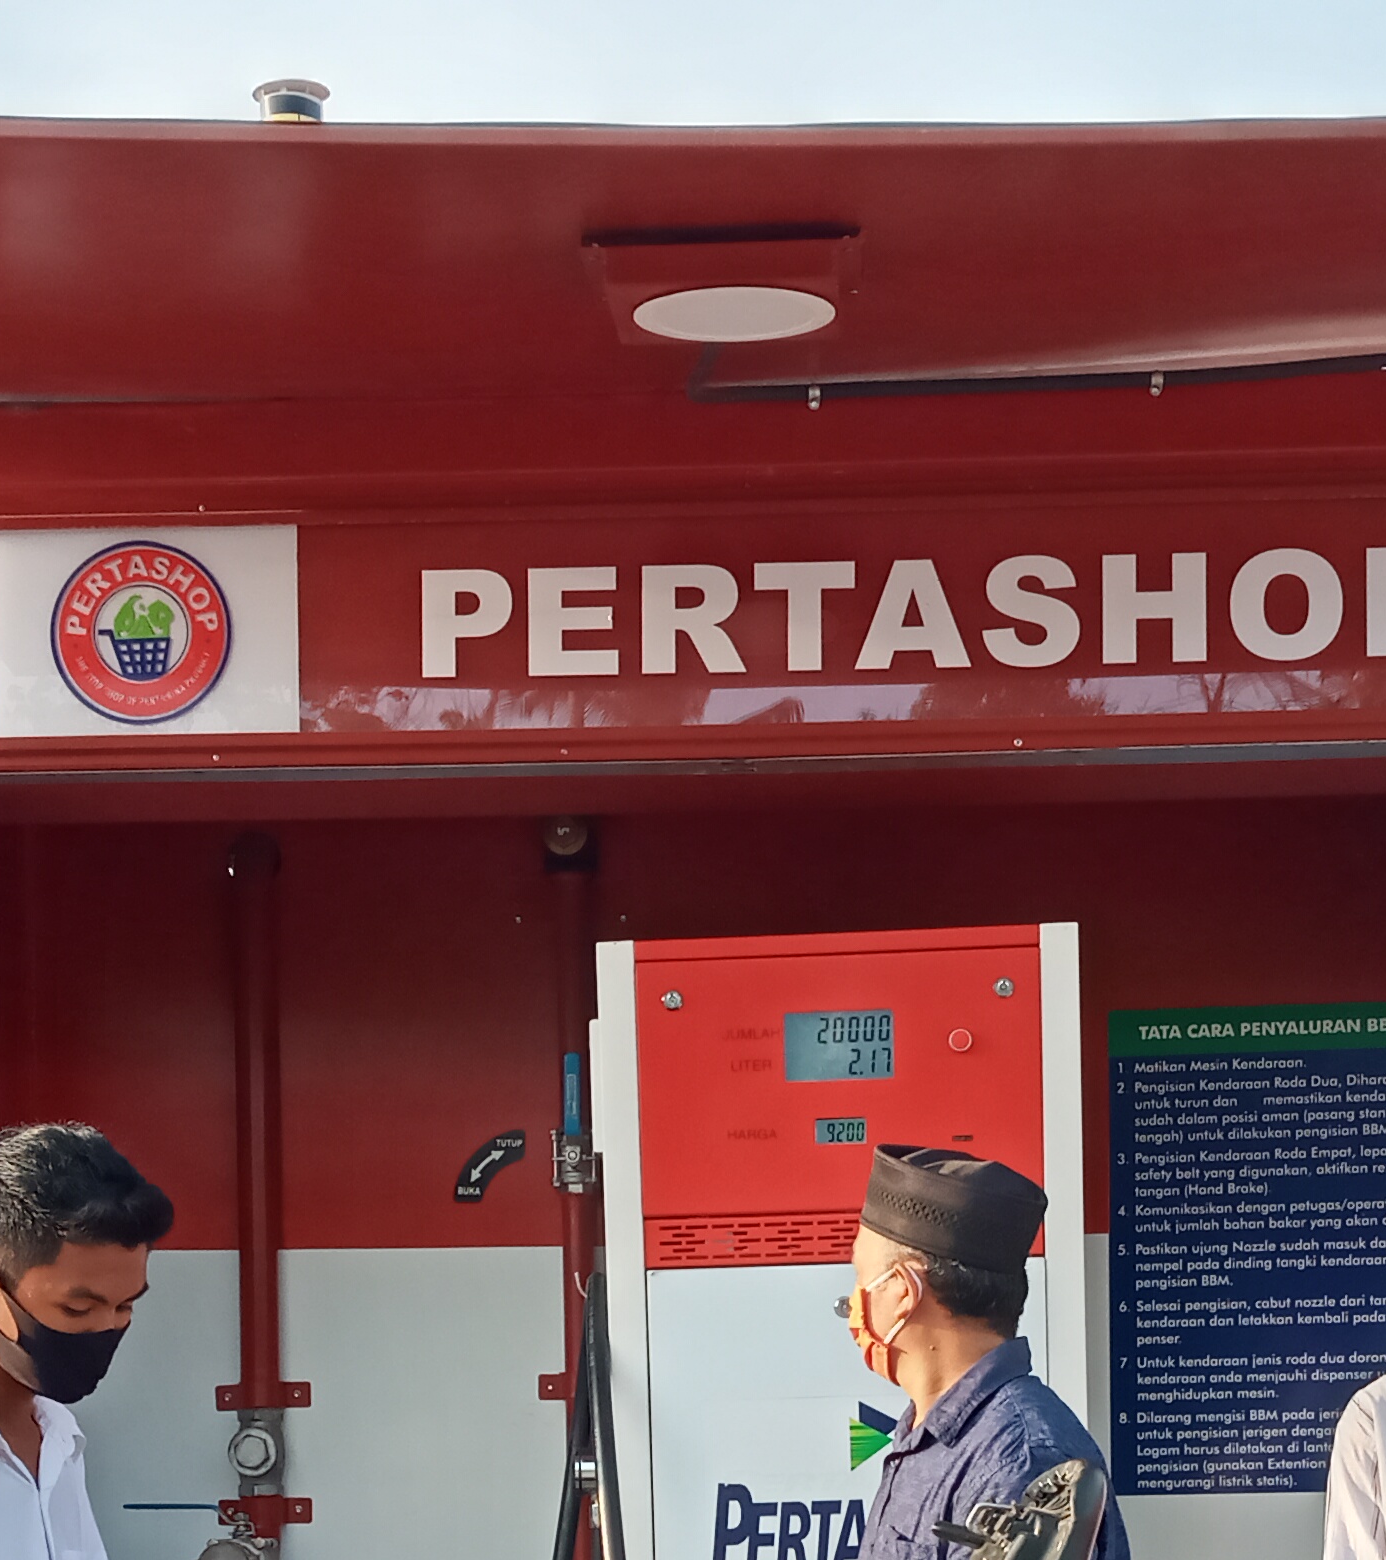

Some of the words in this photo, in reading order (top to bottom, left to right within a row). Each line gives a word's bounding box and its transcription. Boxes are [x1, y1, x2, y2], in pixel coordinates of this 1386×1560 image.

[65, 554, 219, 636] PERTASHOP
[722, 1028, 781, 1041] JUMLAH
[817, 1014, 891, 1045] 20000
[1139, 1025, 1181, 1040] TATA
[1187, 1023, 1234, 1038] CARA
[1240, 1018, 1360, 1036] PENYALURAN
[730, 1059, 773, 1073] LITER
[848, 1046, 892, 1076] 2.17
[1134, 1059, 1185, 1073] Matikan
[1190, 1059, 1228, 1071] Mesin
[1232, 1057, 1306, 1069] Kendaraan.
[1135, 1081, 1195, 1095] Pengisian
[1199, 1078, 1269, 1091] Kendaraan
[1275, 1077, 1306, 1088] Roda
[1311, 1075, 1342, 1088] Dua,
[1135, 1096, 1171, 1109] untuk
[1175, 1096, 1209, 1107] turun
[1213, 1095, 1237, 1107] dan
[1263, 1091, 1342, 1105] memastikan
[1135, 1113, 1173, 1126] sudah
[1177, 1112, 1217, 1125] dalam
[1222, 1111, 1258, 1126] posisi
[1262, 1112, 1299, 1122] aman
[1303, 1109, 1355, 1124] (pasang
[726, 1128, 778, 1141] HARGA
[826, 1121, 866, 1143] 9200
[1135, 1129, 1183, 1145] tengah)
[1188, 1128, 1224, 1140] untuk
[1228, 1125, 1291, 1140] dilakukan
[1295, 1126, 1357, 1139] pengisian
[495, 1138, 524, 1149] TUTUP
[1117, 1153, 1128, 1164] 3.
[1135, 1151, 1195, 1166] Pengisian
[1199, 1149, 1270, 1162] Kendaraan
[1275, 1148, 1306, 1159] Roda
[1311, 1147, 1356, 1160] Empat,
[1135, 1167, 1172, 1182] safety
[1176, 1167, 1200, 1179] belt
[1203, 1168, 1235, 1180] yang
[1239, 1164, 1311, 1179] digunakan,
[1316, 1163, 1368, 1174] aktifkan
[457, 1186, 482, 1196] BUKA
[1135, 1185, 1180, 1200] tangan
[1184, 1183, 1224, 1198] (Hand
[1135, 1202, 1232, 1216] Komunikasikan
[1237, 1201, 1285, 1215] dengan
[1135, 1220, 1171, 1233] untuk
[1175, 1219, 1219, 1233] jumlah
[1224, 1217, 1265, 1230] bahan
[1269, 1216, 1306, 1229] bakar
[1310, 1218, 1341, 1231] yang
[1345, 1216, 1378, 1227] akan
[1118, 1244, 1129, 1255] 5.
[1135, 1243, 1187, 1255] Pastikan
[1192, 1242, 1228, 1257] ujung
[1233, 1241, 1276, 1252] Nozzle
[1280, 1239, 1319, 1252] sudah
[1323, 1238, 1366, 1250] masuk
[1135, 1258, 1183, 1274] nempel
[1187, 1258, 1219, 1272] pada
[1224, 1256, 1272, 1271] dinding
[1276, 1254, 1317, 1268] tangki
[1135, 1276, 1196, 1291] pengisian
[1201, 1275, 1233, 1287] BBM.
[1119, 1301, 1130, 1312] 6.
[1136, 1299, 1181, 1312] Selesai
[1185, 1299, 1251, 1312] pengisian,
[1255, 1297, 1290, 1309] cabut
[1295, 1296, 1335, 1307] nozzle
[1340, 1294, 1365, 1306] dari
[1136, 1316, 1205, 1328] kendaraan
[1209, 1314, 1234, 1327] dan
[1238, 1313, 1292, 1325] letakkan
[1297, 1311, 1349, 1324] kembali
[1353, 1311, 1386, 1325] pada
[1137, 1356, 1175, 1369] Untuk
[1179, 1354, 1248, 1367] kendaraan
[1252, 1353, 1282, 1368] jenis
[1286, 1353, 1315, 1365] roda
[1320, 1352, 1344, 1364] dua
[1137, 1371, 1205, 1385] kendaraan
[1209, 1370, 1242, 1383] anda
[1247, 1367, 1306, 1383] menjauhi
[1311, 1367, 1372, 1382] dispenser
[1137, 1388, 1233, 1404] menghidupkan
[1237, 1388, 1279, 1399] mesin.
[1119, 1413, 1130, 1423] 8.
[1137, 1412, 1192, 1426] Dilarang
[1196, 1410, 1245, 1425] mengisi
[1249, 1409, 1278, 1420] BBM
[1282, 1408, 1315, 1422] pada
[1137, 1427, 1172, 1440] untuk
[1177, 1426, 1238, 1442] pengisian
[1242, 1425, 1287, 1440] jerigen
[1291, 1424, 1335, 1438] denga
[1137, 1443, 1180, 1458] Logam
[1184, 1442, 1220, 1455] harus
[1224, 1441, 1283, 1454] diletakan
[1287, 1440, 1300, 1453] di
[1137, 1460, 1198, 1475] pengisian
[1203, 1458, 1263, 1474] (gunakan
[1267, 1456, 1326, 1469] Extention
[1138, 1474, 1214, 1490] mengurangi
[1218, 1474, 1253, 1487] listrik
[1257, 1471, 1297, 1487] statis).
